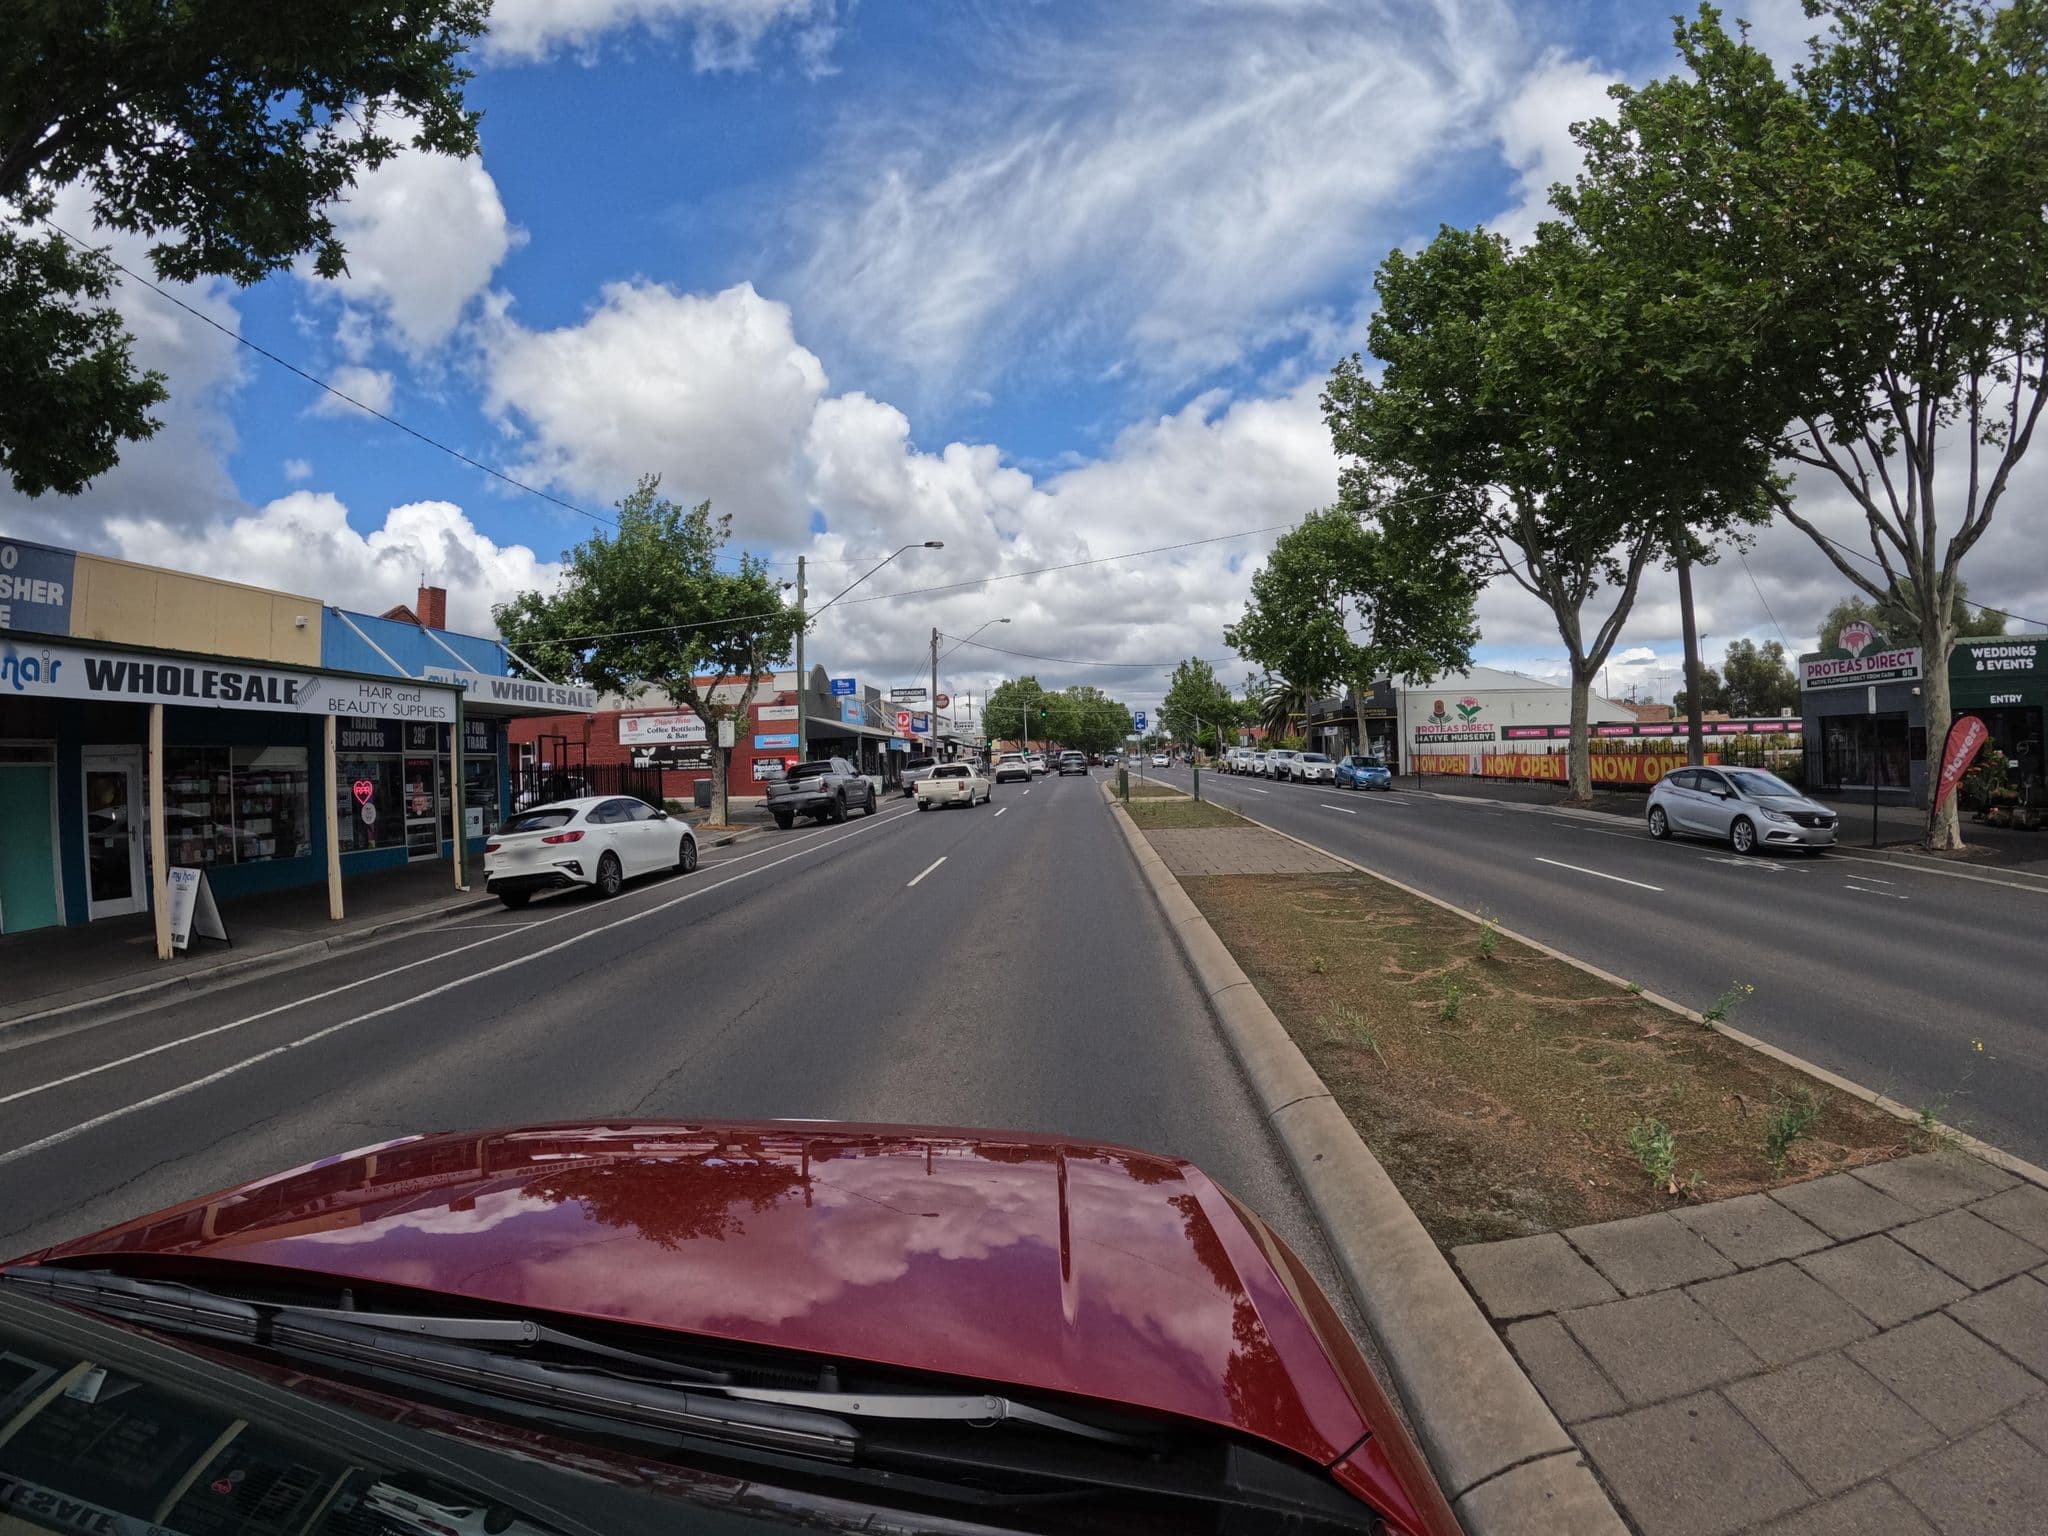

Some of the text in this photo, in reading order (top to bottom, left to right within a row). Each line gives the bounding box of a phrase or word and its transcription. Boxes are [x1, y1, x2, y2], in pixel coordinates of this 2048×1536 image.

[1970, 645, 2037, 659] WEDDINGS
[1807, 651, 1914, 677] PROTEAS DIRECT
[1975, 658, 2034, 671] & EVENTS
[84, 658, 300, 705] WHOLESALE
[360, 684, 421, 702] HAIR and
[491, 680, 593, 708] WHOLESALE
[892, 689, 924, 697] NEWSAGENT
[1990, 694, 2022, 704] ENTRY
[328, 698, 446, 719] BEAUTY SUPPLIES
[350, 717, 378, 730] TRADE
[1136, 712, 1144, 722] P
[471, 721, 485, 735] FOR
[671, 725, 705, 733] Bottlesho
[1415, 723, 1494, 733] PROTEAS DIRECT
[342, 731, 385, 748] SUPPLIES
[467, 736, 488, 750] TRADE
[1416, 733, 1492, 743] NATIVE NURSERY
[1440, 756, 1466, 773] OPEN
[1486, 756, 1560, 778] NOW OPEN
[1591, 756, 1638, 780] NOW
